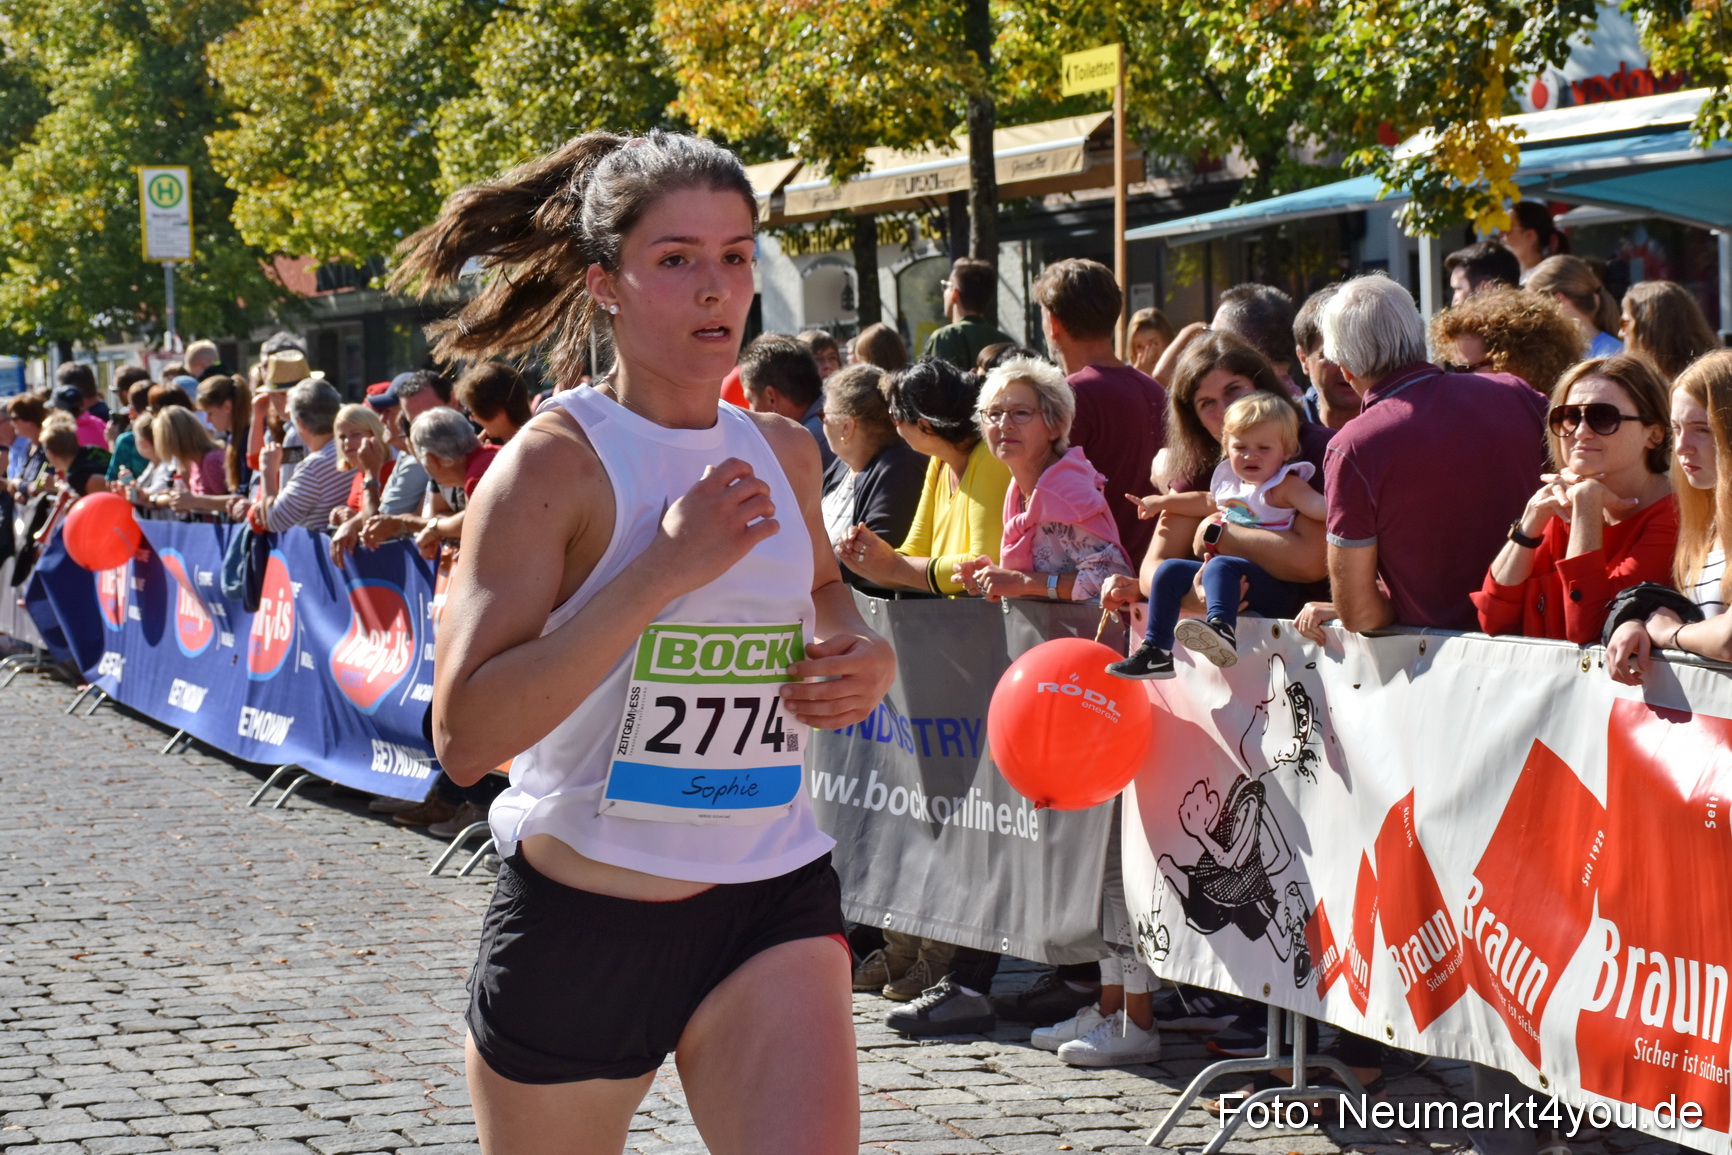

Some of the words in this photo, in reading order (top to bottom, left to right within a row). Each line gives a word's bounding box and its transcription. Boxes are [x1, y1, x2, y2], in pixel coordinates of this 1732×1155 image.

[1073, 61, 1116, 82] Toiletten
[157, 182, 174, 201] H
[653, 633, 793, 674] BOCK
[1037, 672, 1121, 717] RÖDL
[1081, 701, 1119, 723] energie
[644, 695, 785, 756] 2774
[833, 703, 981, 758] NDUSTRY
[682, 775, 760, 805] Sophie
[1704, 796, 1719, 829] Seit
[1582, 863, 1593, 887] Seit
[1589, 830, 1605, 860] 1929
[1387, 909, 1456, 995] Braun
[1461, 874, 1549, 1015] Braun
[1426, 970, 1449, 992] Sicher
[1446, 961, 1456, 975] ist
[1581, 917, 1728, 1044] Braun
[1507, 1000, 1517, 1020] ist
[1634, 1037, 1678, 1069] Sicher
[1682, 1049, 1699, 1075] ist
[1699, 1055, 1730, 1085] sicher
